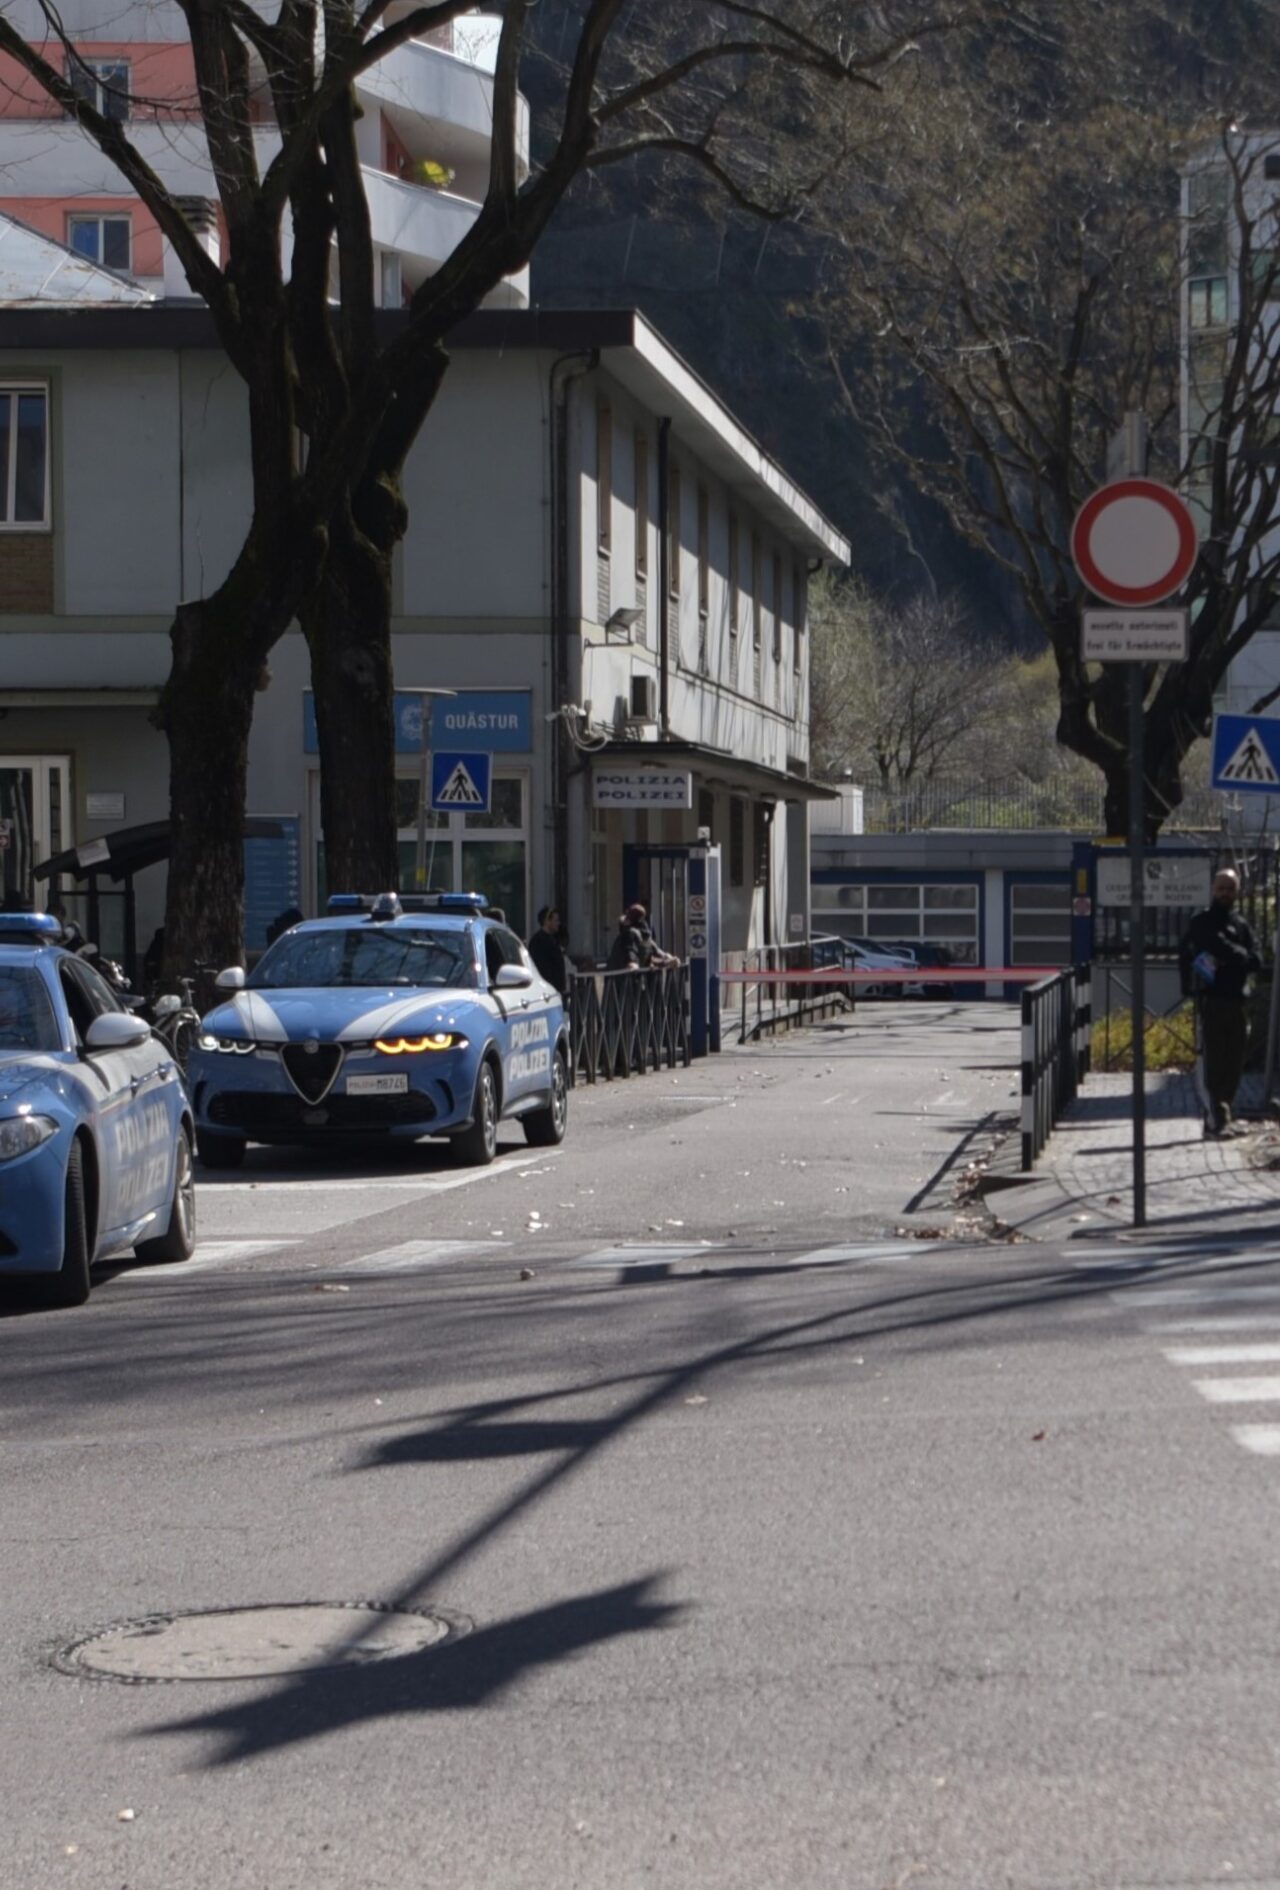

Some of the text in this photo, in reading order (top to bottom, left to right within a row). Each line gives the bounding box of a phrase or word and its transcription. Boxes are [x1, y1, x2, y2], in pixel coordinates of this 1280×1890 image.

[444, 712, 519, 730] QUÄSTUR
[596, 775, 685, 785] POLIZIA
[598, 790, 684, 800] POLIZEI
[511, 1016, 549, 1049] POLIZIA
[509, 1047, 550, 1082] POLIZEI
[115, 1100, 170, 1163] POLIZIA
